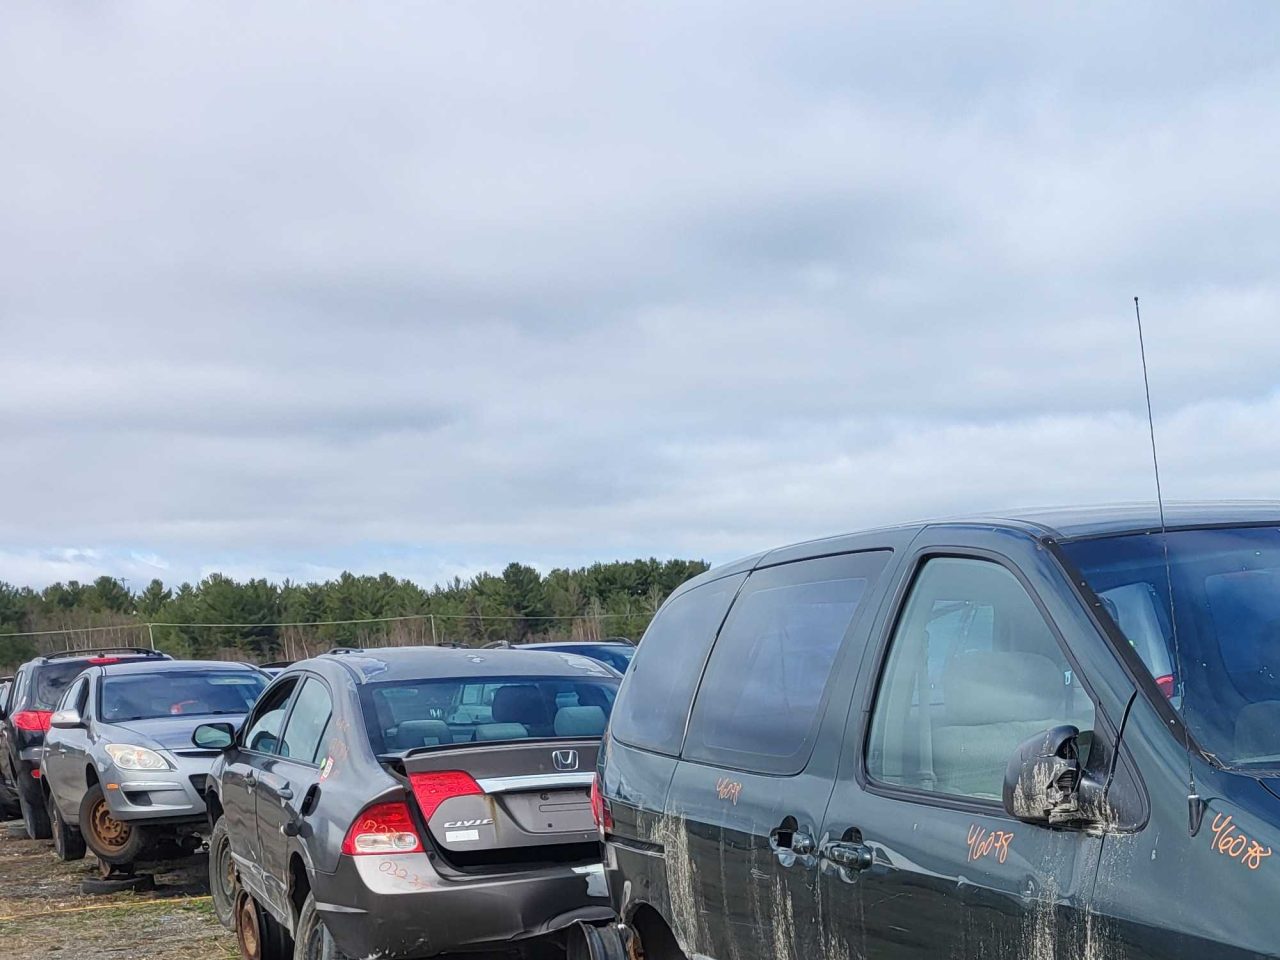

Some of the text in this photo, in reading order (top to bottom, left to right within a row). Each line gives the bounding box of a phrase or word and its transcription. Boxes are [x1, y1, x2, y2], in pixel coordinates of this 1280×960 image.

[443, 818, 494, 828] CIVIC
[967, 823, 1014, 864] 46078
[1210, 812, 1272, 869] 46078
